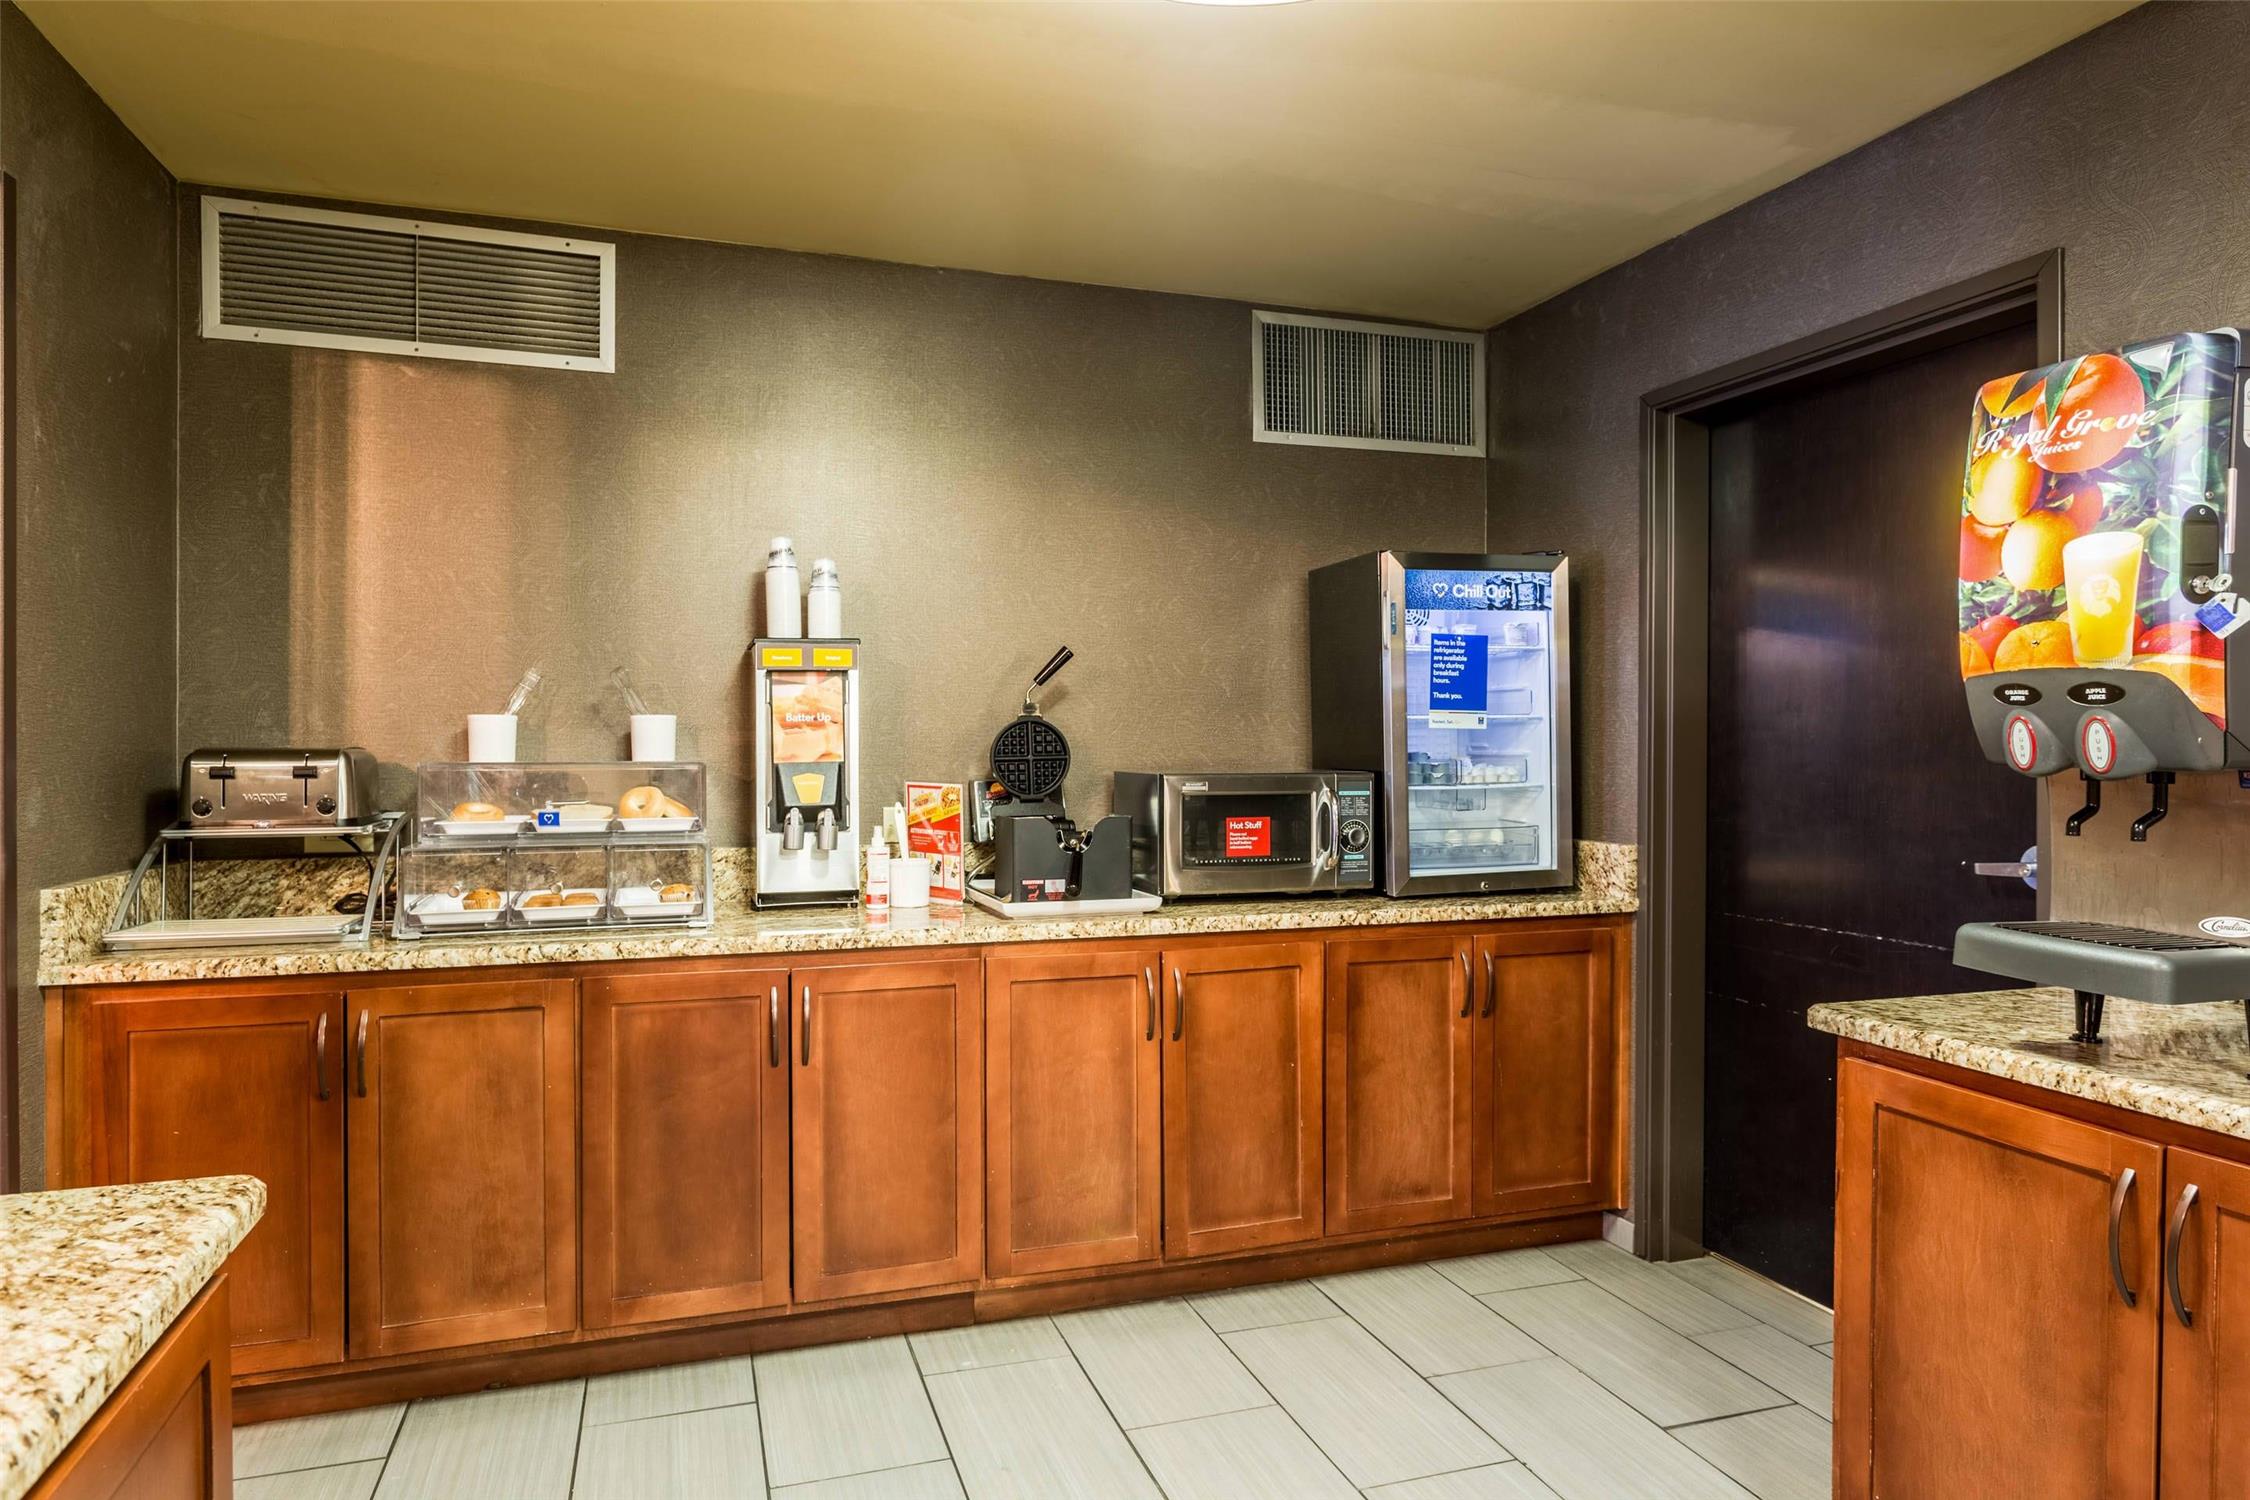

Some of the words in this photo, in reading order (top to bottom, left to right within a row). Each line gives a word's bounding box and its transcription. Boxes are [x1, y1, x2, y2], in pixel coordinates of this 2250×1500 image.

[2028, 440, 2084, 462] Juices
[1452, 584, 1482, 598] Chill
[1486, 584, 1511, 598] Out
[785, 712, 815, 721] Batter
[817, 712, 831, 722] Up
[2094, 729, 2103, 761] PUSH
[1244, 821, 1262, 829] Stuff
